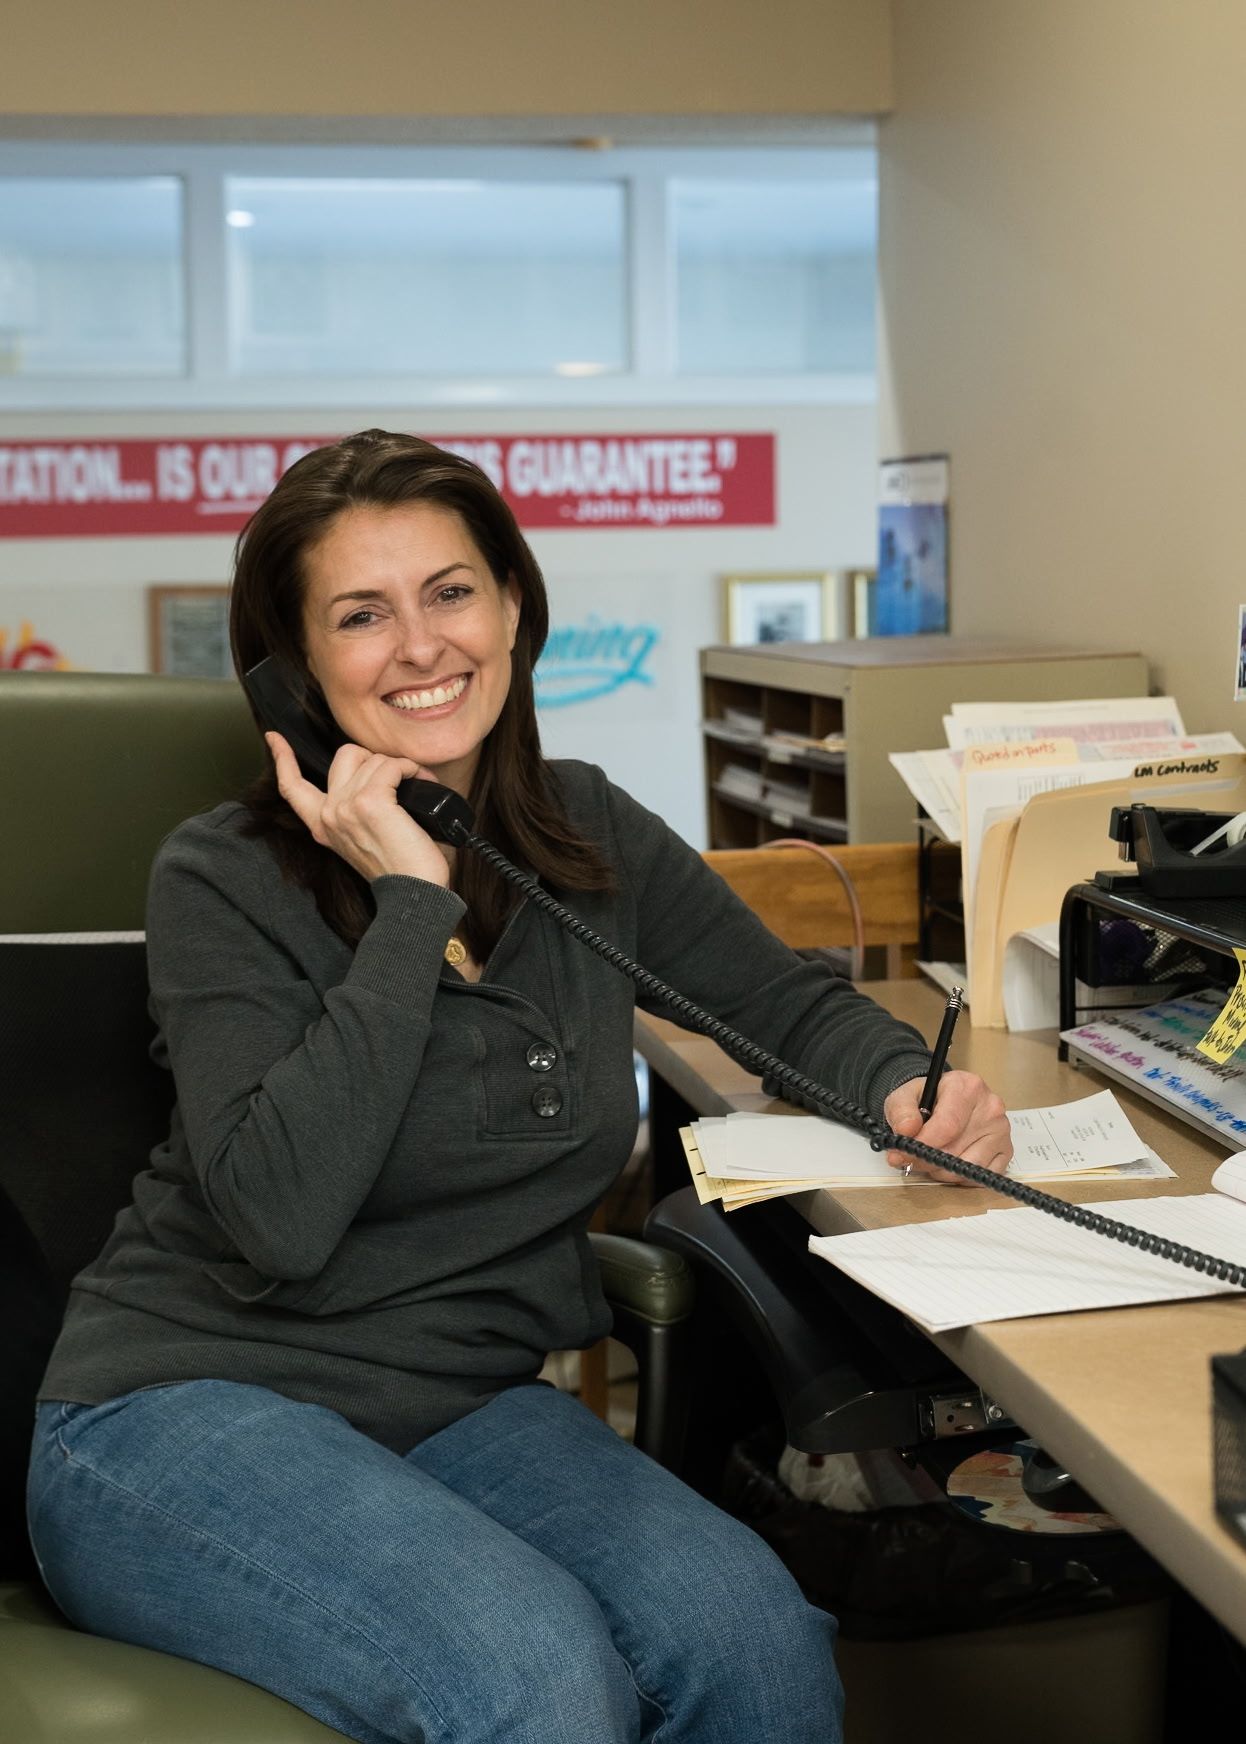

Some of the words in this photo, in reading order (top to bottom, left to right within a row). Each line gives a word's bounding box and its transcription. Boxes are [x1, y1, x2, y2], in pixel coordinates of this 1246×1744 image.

[156, 445, 196, 501] IS
[200, 443, 279, 499] OUR
[1157, 758, 1220, 776] Contracts
